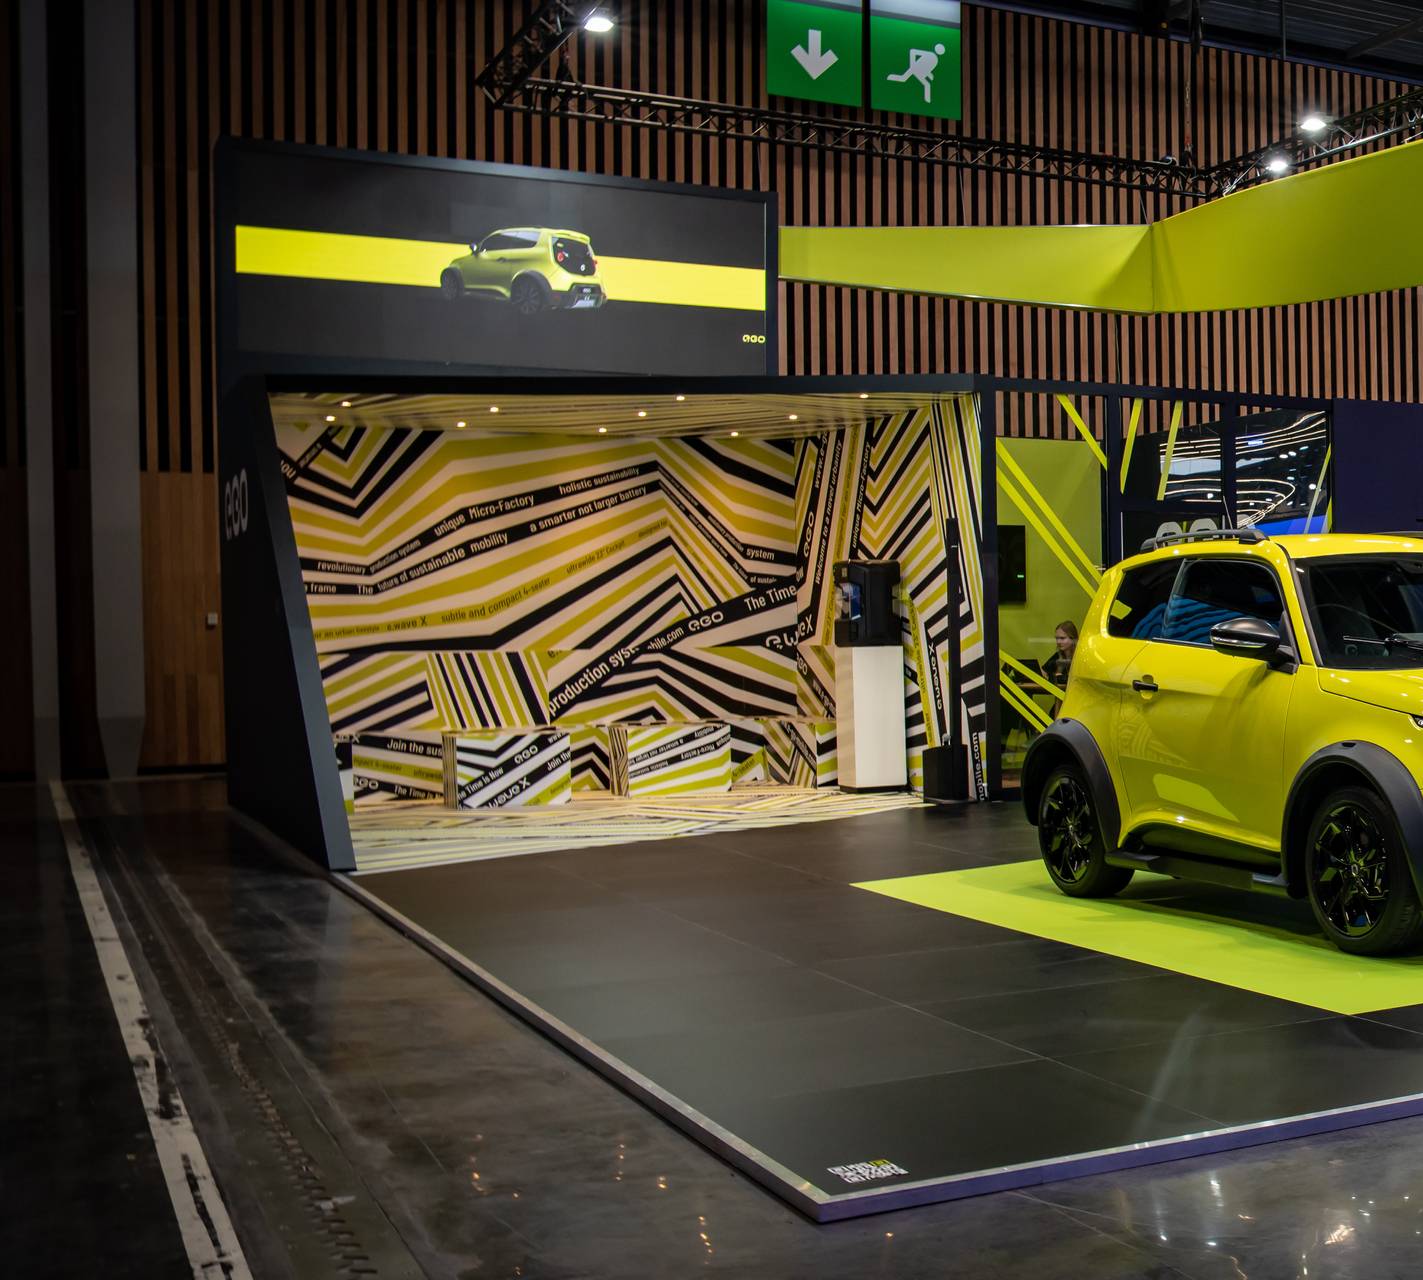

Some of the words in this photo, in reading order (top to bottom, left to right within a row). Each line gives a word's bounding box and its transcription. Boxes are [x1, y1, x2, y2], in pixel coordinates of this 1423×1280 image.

[558, 480, 592, 495] holistic
[593, 467, 640, 485] sustainability
[826, 486, 835, 516] novel
[831, 440, 842, 486] urbanity
[852, 514, 861, 548] unique
[857, 442, 871, 512] Micro-Factory
[434, 513, 466, 536] unique
[468, 495, 534, 519] Micro-Factory
[529, 522, 537, 533] a
[539, 509, 576, 529] smarter
[578, 505, 593, 517] not
[594, 496, 618, 511] larger
[619, 486, 647, 502] battery
[317, 561, 366, 575] revolutionary
[357, 585, 374, 595] The
[399, 572, 409, 583] of
[408, 547, 465, 579] sustainable
[470, 532, 508, 552] mobility
[746, 548, 775, 560] system
[310, 583, 337, 593] frame
[441, 611, 466, 624] subtle
[468, 606, 486, 619] and
[488, 591, 522, 613] compact
[523, 577, 550, 596] 4-seater
[743, 595, 766, 611] The
[765, 584, 797, 603] Time
[387, 620, 418, 631] e.wave
[419, 616, 428, 628] X
[549, 661, 611, 716] production
[387, 739, 407, 751] Join
[409, 742, 424, 754] the
[466, 780, 484, 795] Time
[482, 775, 491, 784] is
[488, 767, 504, 778] Now
[518, 777, 531, 789] X
[547, 758, 562, 771] Join
[394, 784, 407, 795] The
